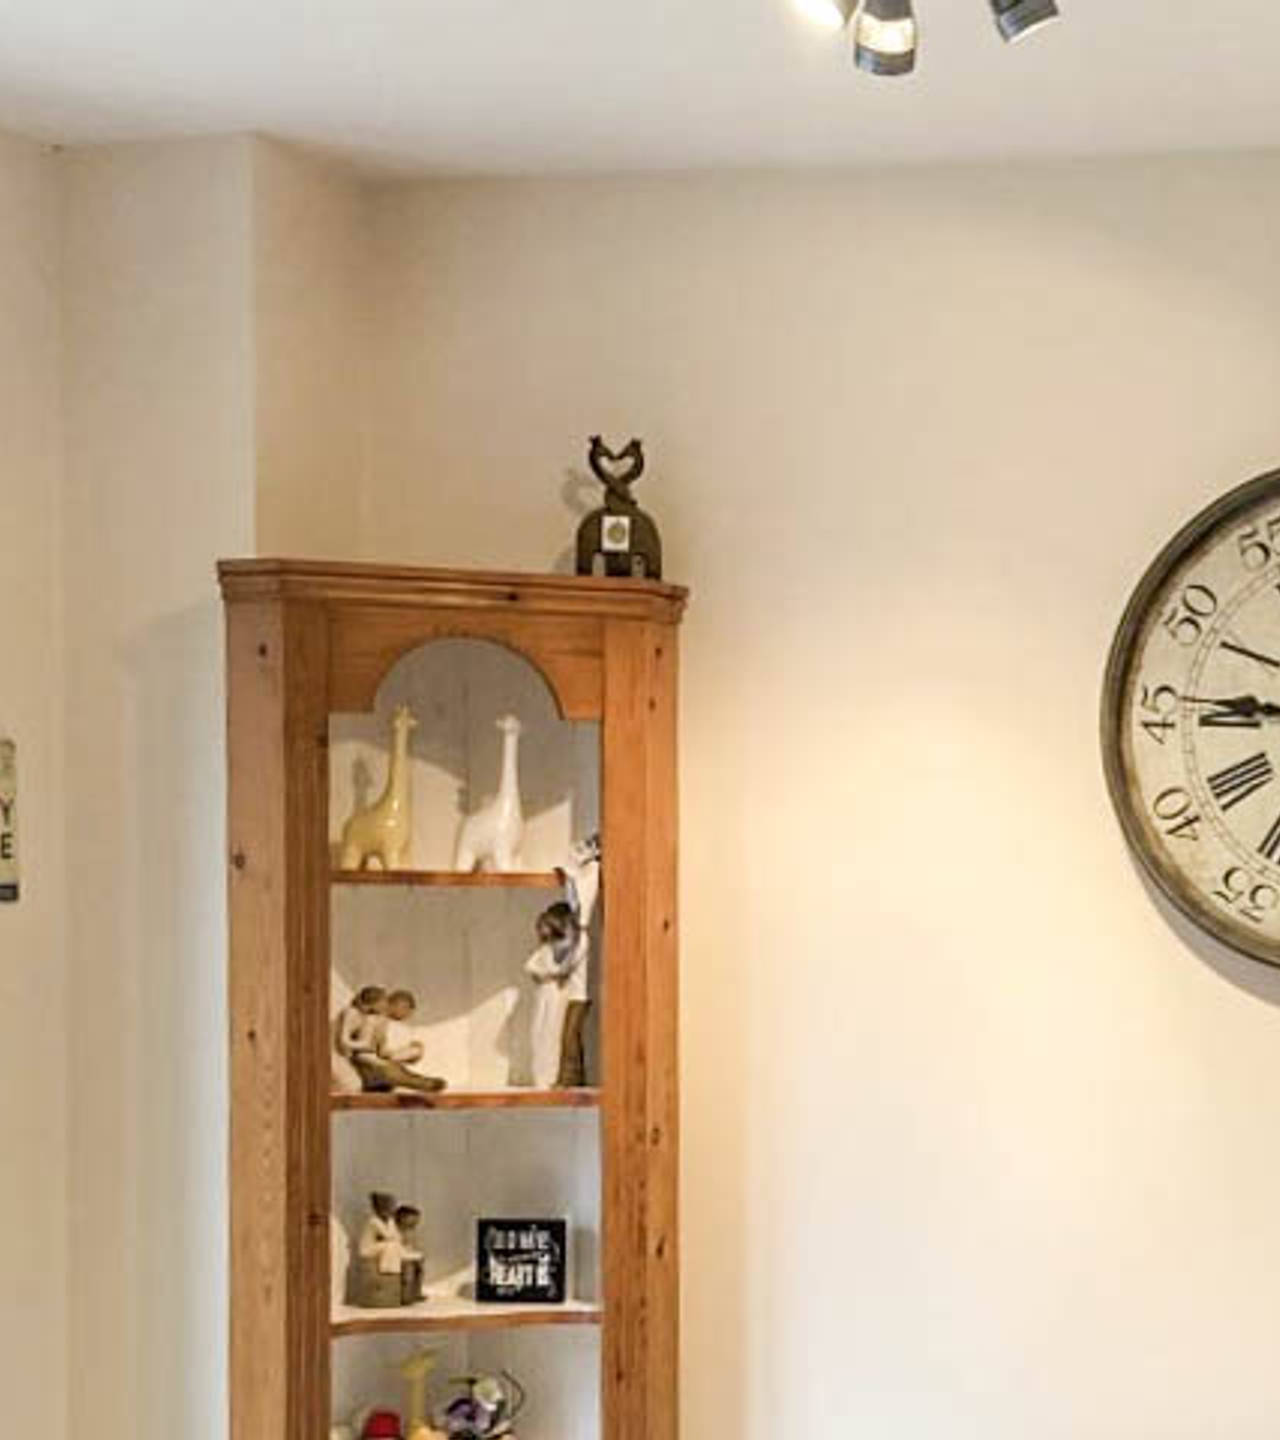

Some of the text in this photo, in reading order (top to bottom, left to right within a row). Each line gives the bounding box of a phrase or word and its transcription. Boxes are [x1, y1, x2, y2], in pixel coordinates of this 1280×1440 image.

[1163, 582, 1219, 647] 50
[1140, 683, 1179, 743] 45
[1152, 784, 1202, 842] 40
